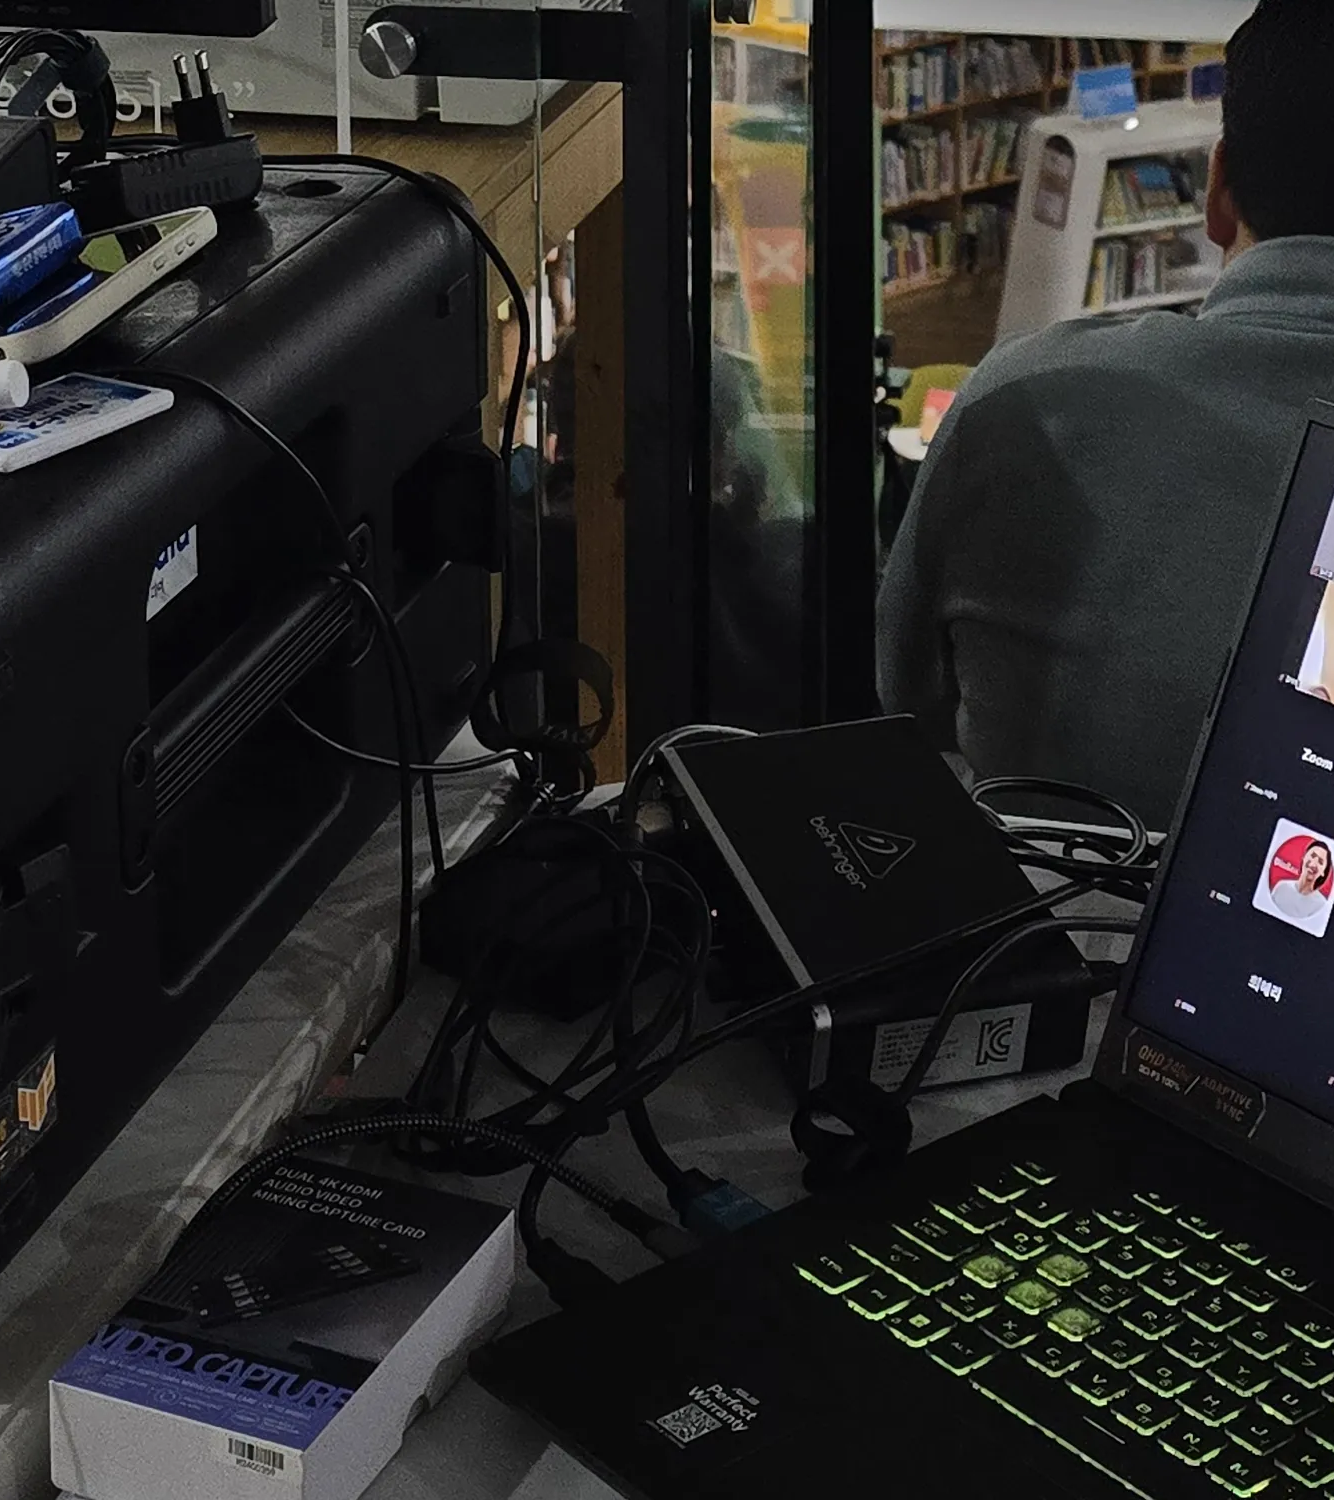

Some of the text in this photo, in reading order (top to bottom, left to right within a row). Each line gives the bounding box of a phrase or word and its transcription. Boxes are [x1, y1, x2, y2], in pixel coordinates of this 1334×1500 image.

[1300, 746, 1334, 773] Zoom
[808, 815, 868, 891] behringer
[1137, 1044, 1166, 1067] QHD
[1200, 1076, 1254, 1111] ADAPTIVE
[261, 1178, 364, 1209] AUDIO VIDEO
[274, 1165, 384, 1201] DUAL 4K HDMI
[251, 1188, 427, 1241] MIXING CAPTURE CARD
[90, 1323, 194, 1368] VIDEO
[688, 1385, 750, 1433] Warranty
[706, 1383, 758, 1421] Perfect
